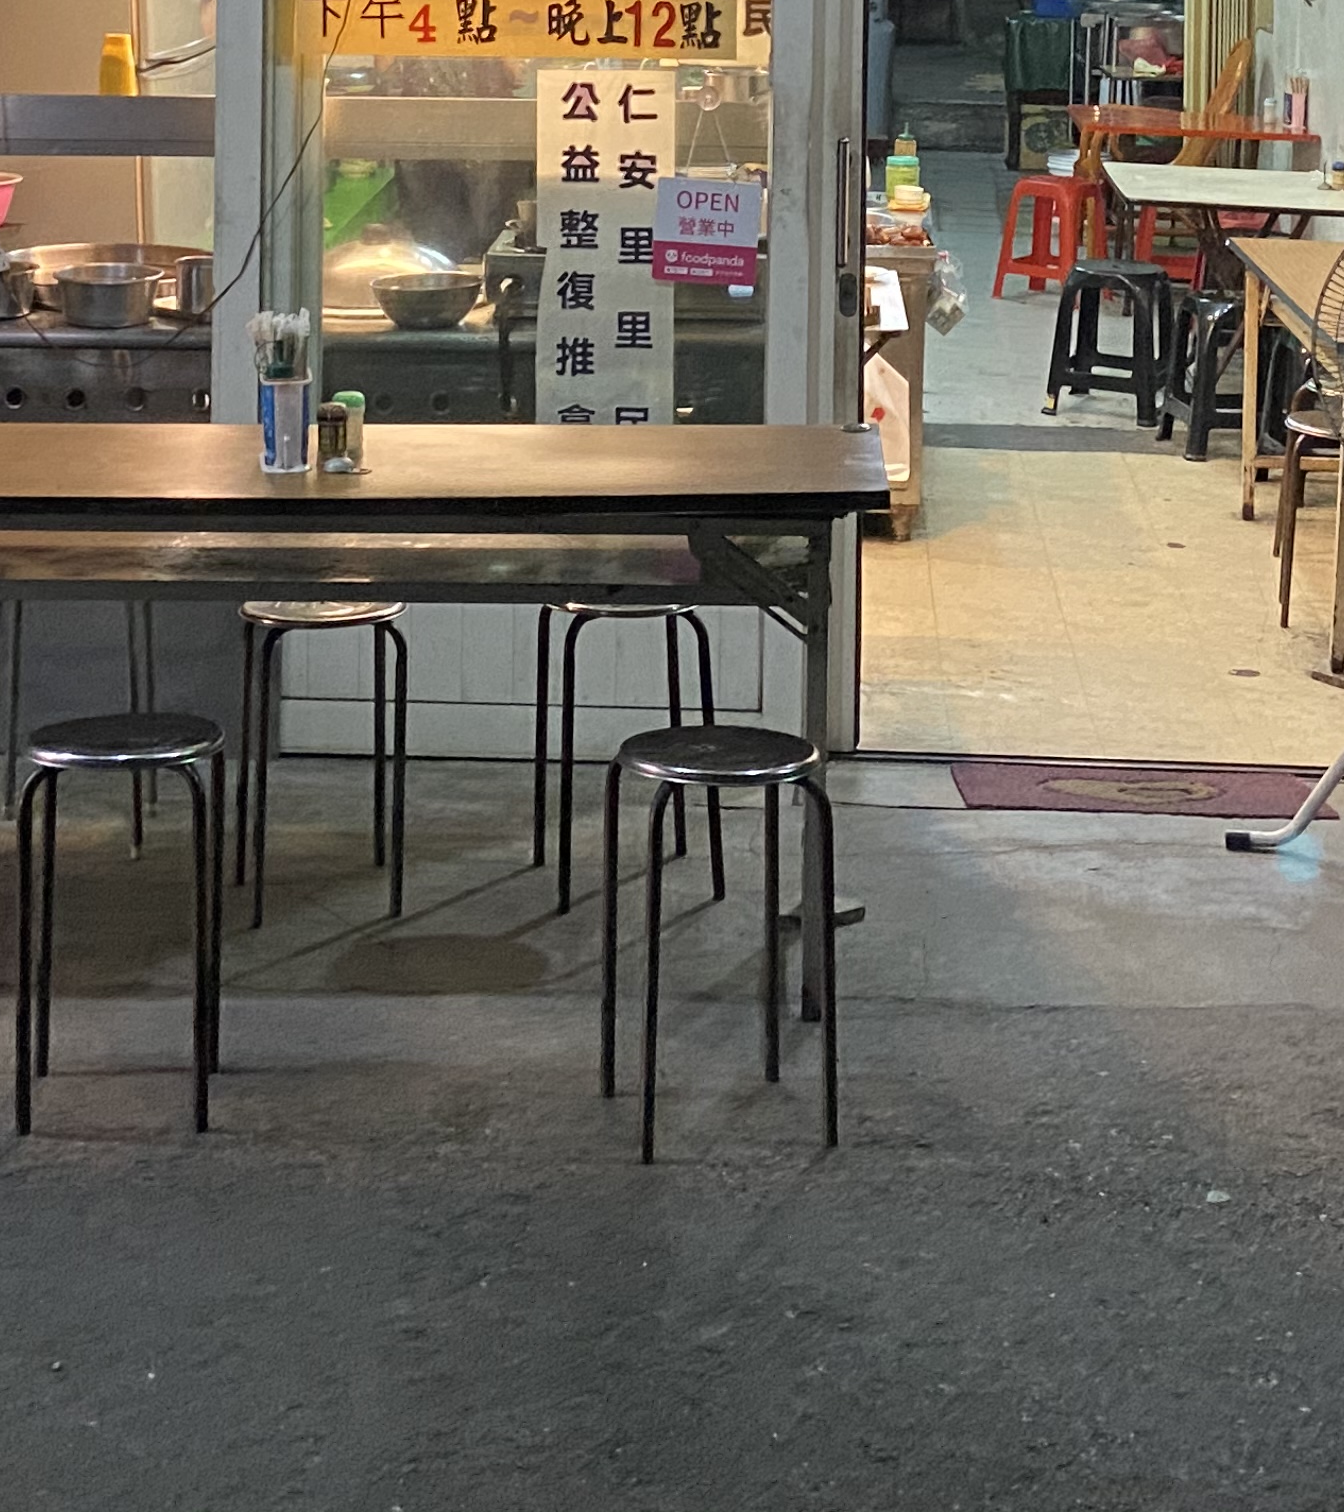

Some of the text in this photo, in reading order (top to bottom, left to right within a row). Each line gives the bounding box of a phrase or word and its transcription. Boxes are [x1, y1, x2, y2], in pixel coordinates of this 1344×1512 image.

[676, 190, 740, 213] OPEN
[678, 216, 735, 238] 營業中
[681, 251, 744, 267] foodpanda
